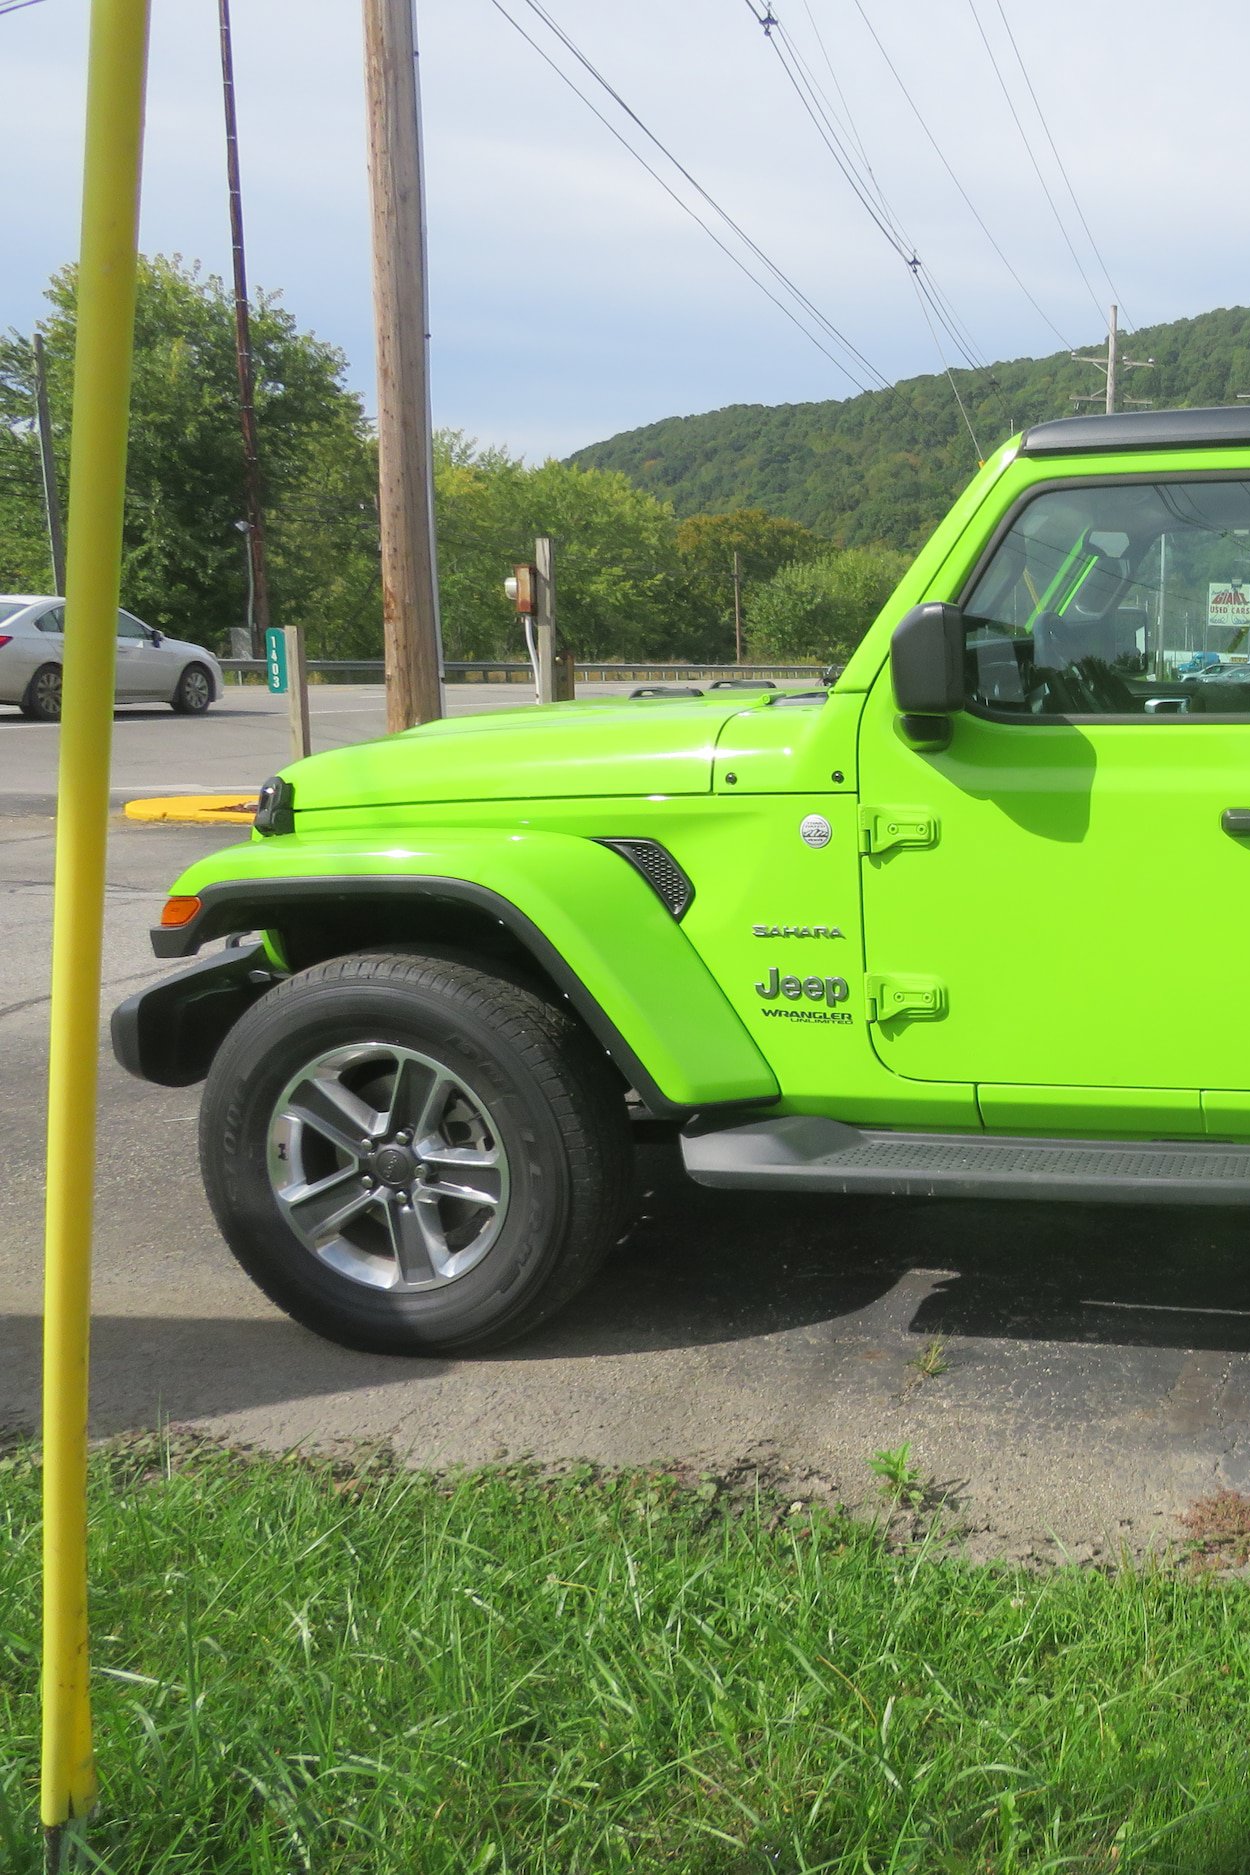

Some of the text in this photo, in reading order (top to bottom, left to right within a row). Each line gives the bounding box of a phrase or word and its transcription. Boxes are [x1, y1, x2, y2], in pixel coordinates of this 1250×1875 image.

[1212, 591, 1250, 605] GIANT
[1210, 606, 1228, 614] USED
[270, 635, 280, 688] 1403
[752, 925, 846, 939] SAHARA
[754, 967, 849, 1008] Jeep
[761, 1008, 853, 1020] WRANGLER
[791, 1017, 854, 1025] UNLIMITED
